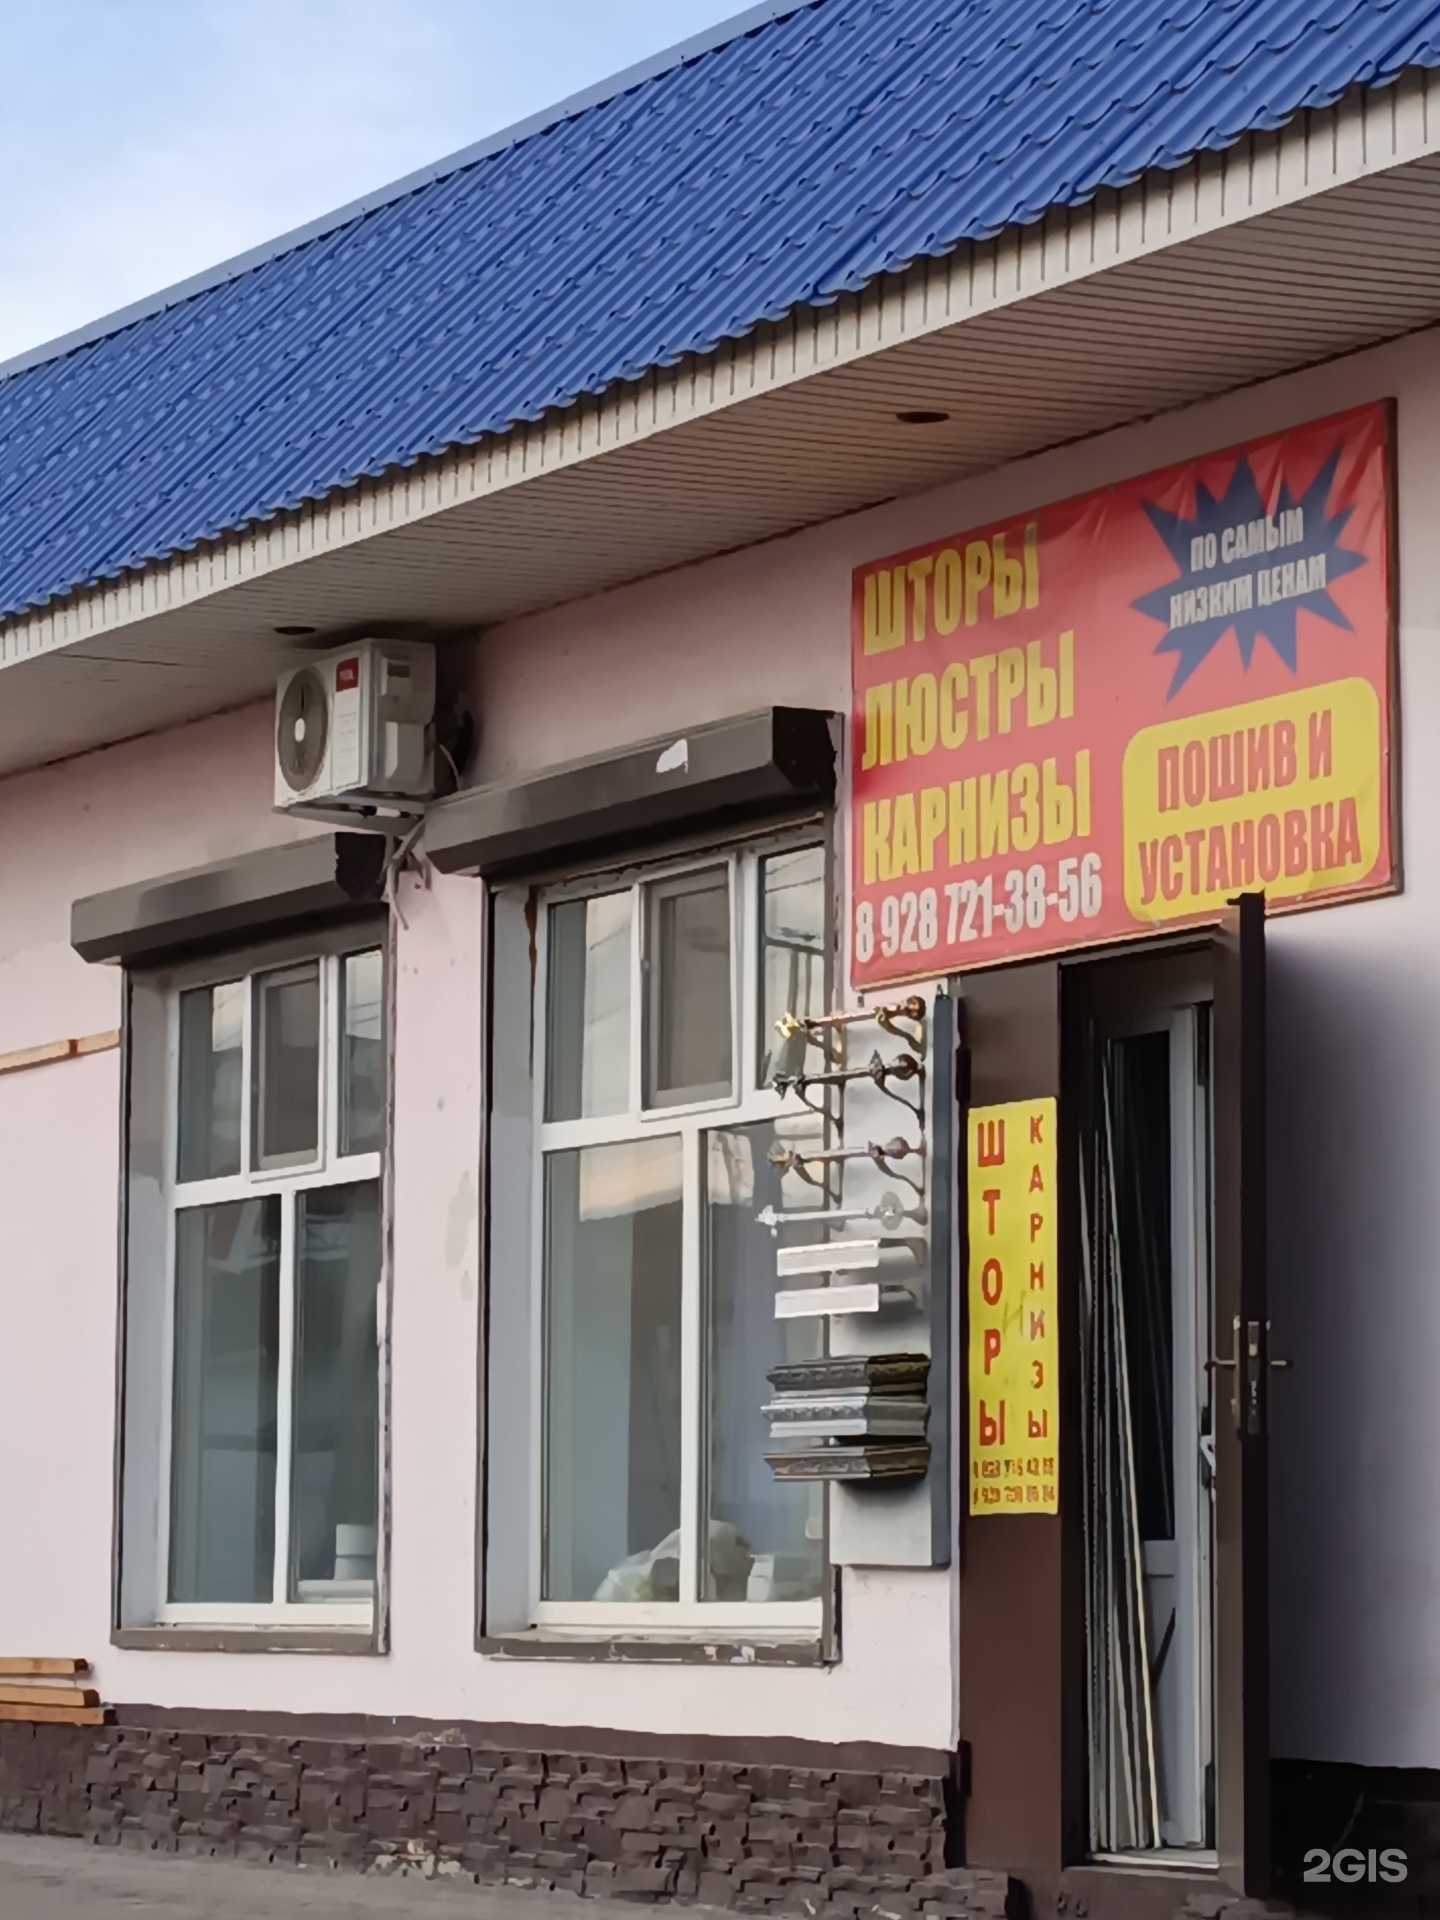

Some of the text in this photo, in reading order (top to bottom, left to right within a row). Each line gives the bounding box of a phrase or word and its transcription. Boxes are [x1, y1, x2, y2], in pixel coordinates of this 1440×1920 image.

[863, 522, 1040, 657] ШТОРЫ
[1168, 552, 1327, 631] НИЗКИМ ЦЕНАМ
[1191, 506, 1304, 573] ПО САМЫМ
[861, 629, 1075, 771] ЛЮСТРЫ
[1157, 708, 1333, 814] ПОШИВ И
[863, 748, 1092, 886] КАРНИЗЫ
[1138, 796, 1363, 907] УСТАНОВКА
[855, 851, 1104, 963] 8 928 721-38-56
[976, 1118, 1006, 1447] ШТОРЫ
[1028, 1113, 1049, 1439] КАРНИЗЫ
